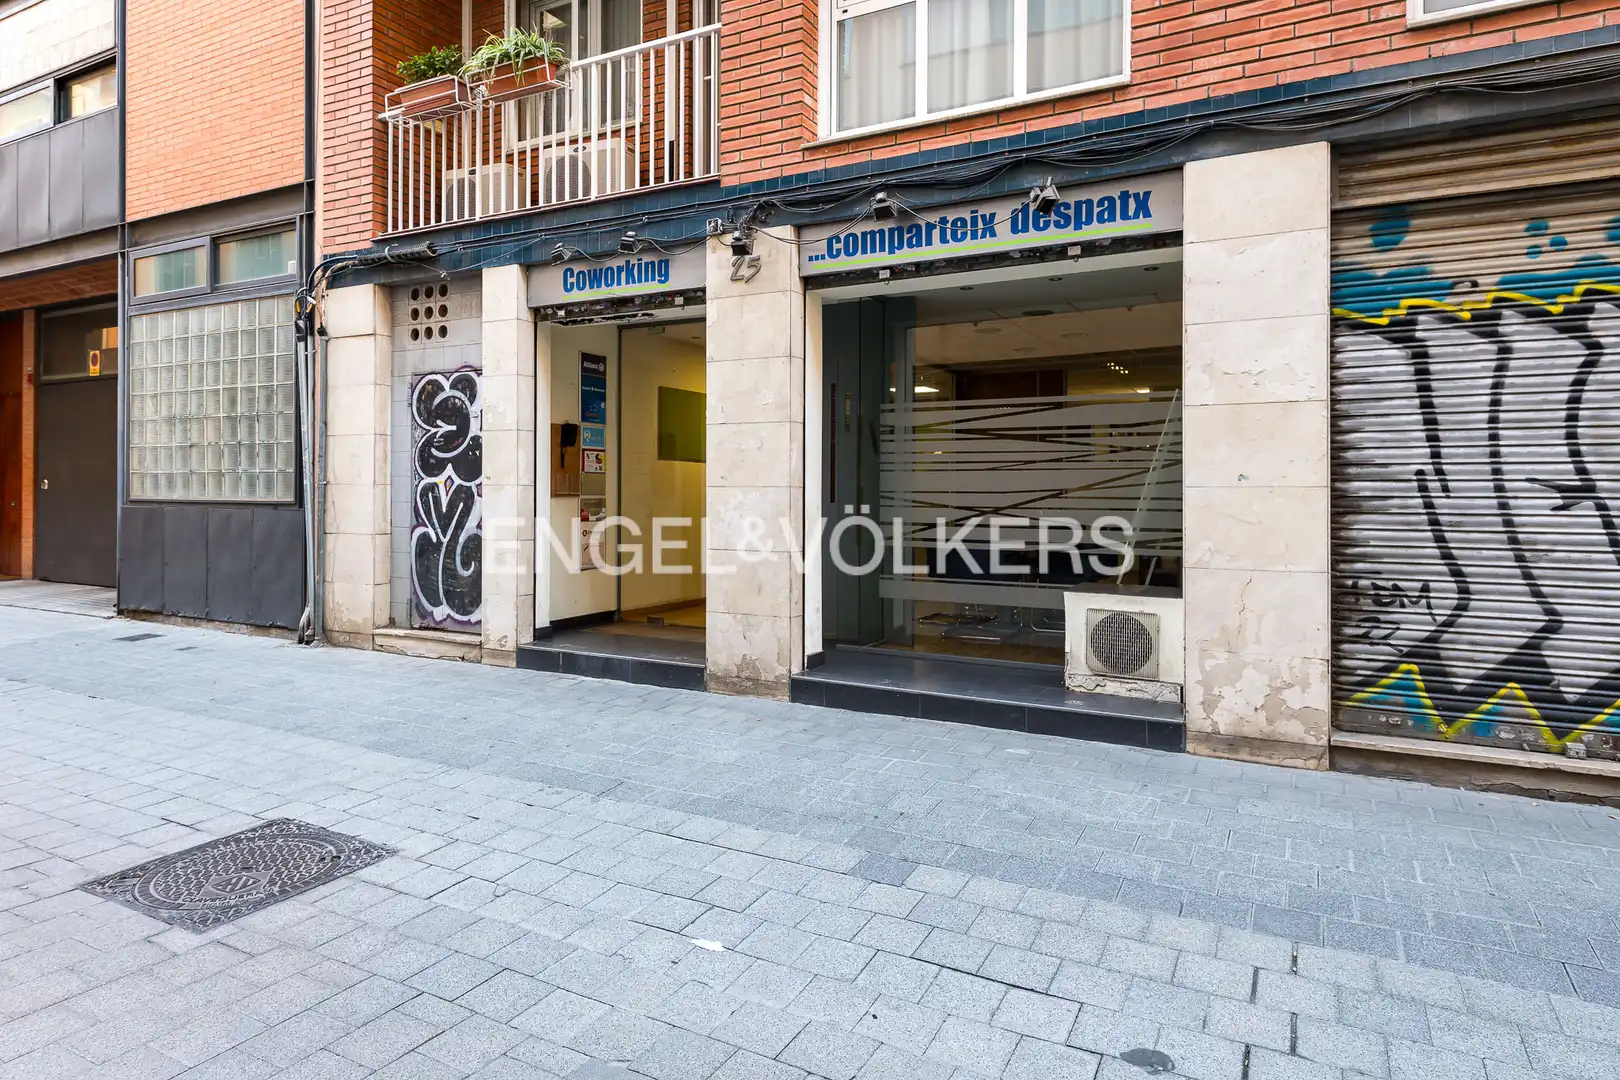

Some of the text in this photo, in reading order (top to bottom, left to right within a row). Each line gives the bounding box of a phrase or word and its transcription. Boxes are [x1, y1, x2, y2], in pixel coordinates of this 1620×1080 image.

[1010, 189, 1153, 235] despatx
[562, 257, 671, 294] Coworking
[730, 254, 762, 284] 25
[583, 361, 599, 370] Allianz
